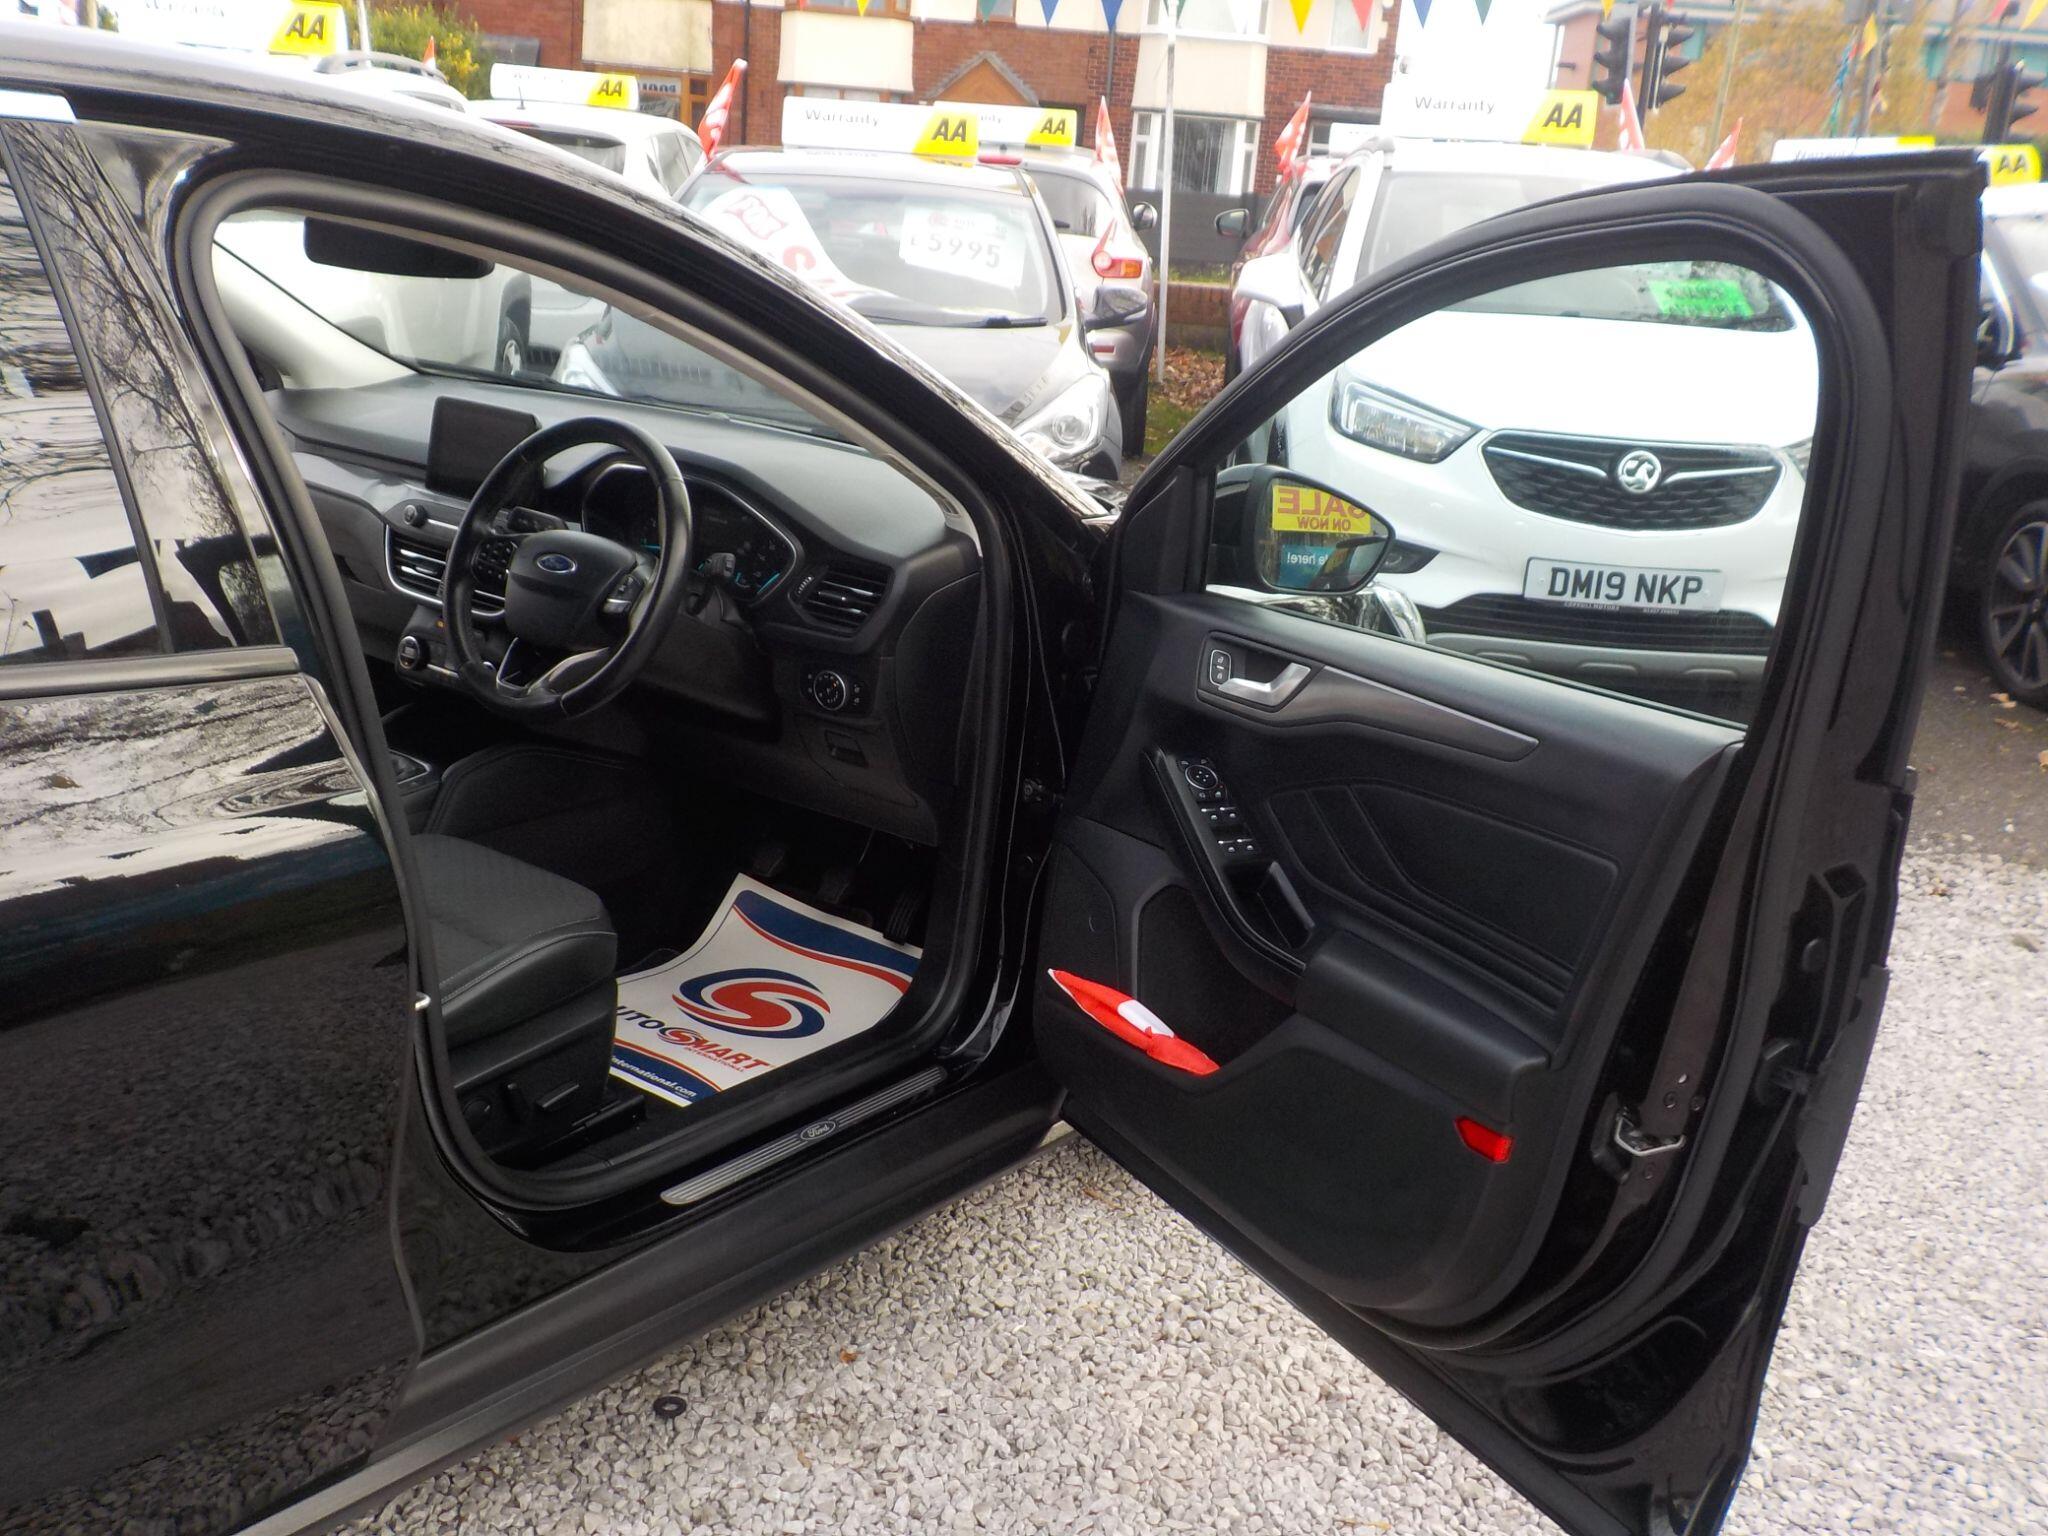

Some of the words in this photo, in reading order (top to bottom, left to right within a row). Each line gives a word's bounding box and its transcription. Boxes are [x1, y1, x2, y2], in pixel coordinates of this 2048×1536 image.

[285, 12, 326, 41] AA
[597, 79, 624, 98] AA
[804, 109, 880, 128] Warranty
[931, 117, 968, 143] AA
[1039, 116, 1067, 136] AA
[1414, 96, 1496, 114] Warranty
[1542, 102, 1584, 129] AA
[1996, 154, 2029, 174] AA
[1547, 566, 1627, 601] DM19
[1633, 572, 1704, 605] NKP
